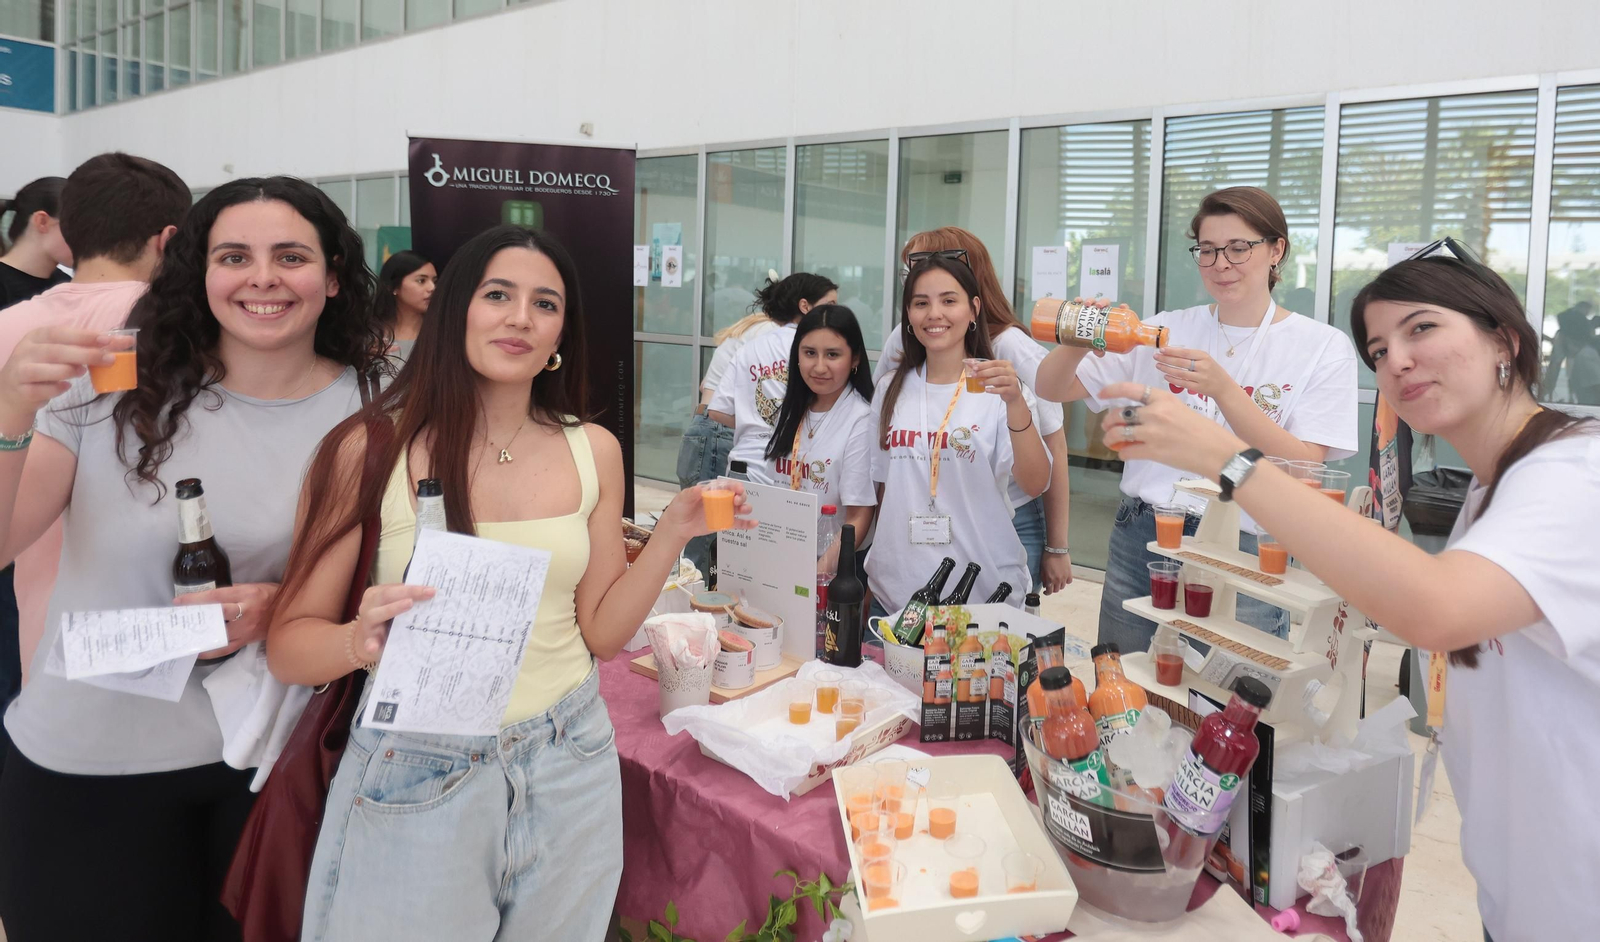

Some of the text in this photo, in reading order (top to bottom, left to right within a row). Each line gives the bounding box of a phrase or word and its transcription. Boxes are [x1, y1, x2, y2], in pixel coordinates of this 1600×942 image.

[453, 166, 620, 194] MIGUEL DOMECQ
[1089, 267, 1111, 276] lasalá
[750, 360, 786, 382] Staff
[1050, 800, 1088, 826] GARCÍA
[1052, 812, 1090, 838] MILLÁN
